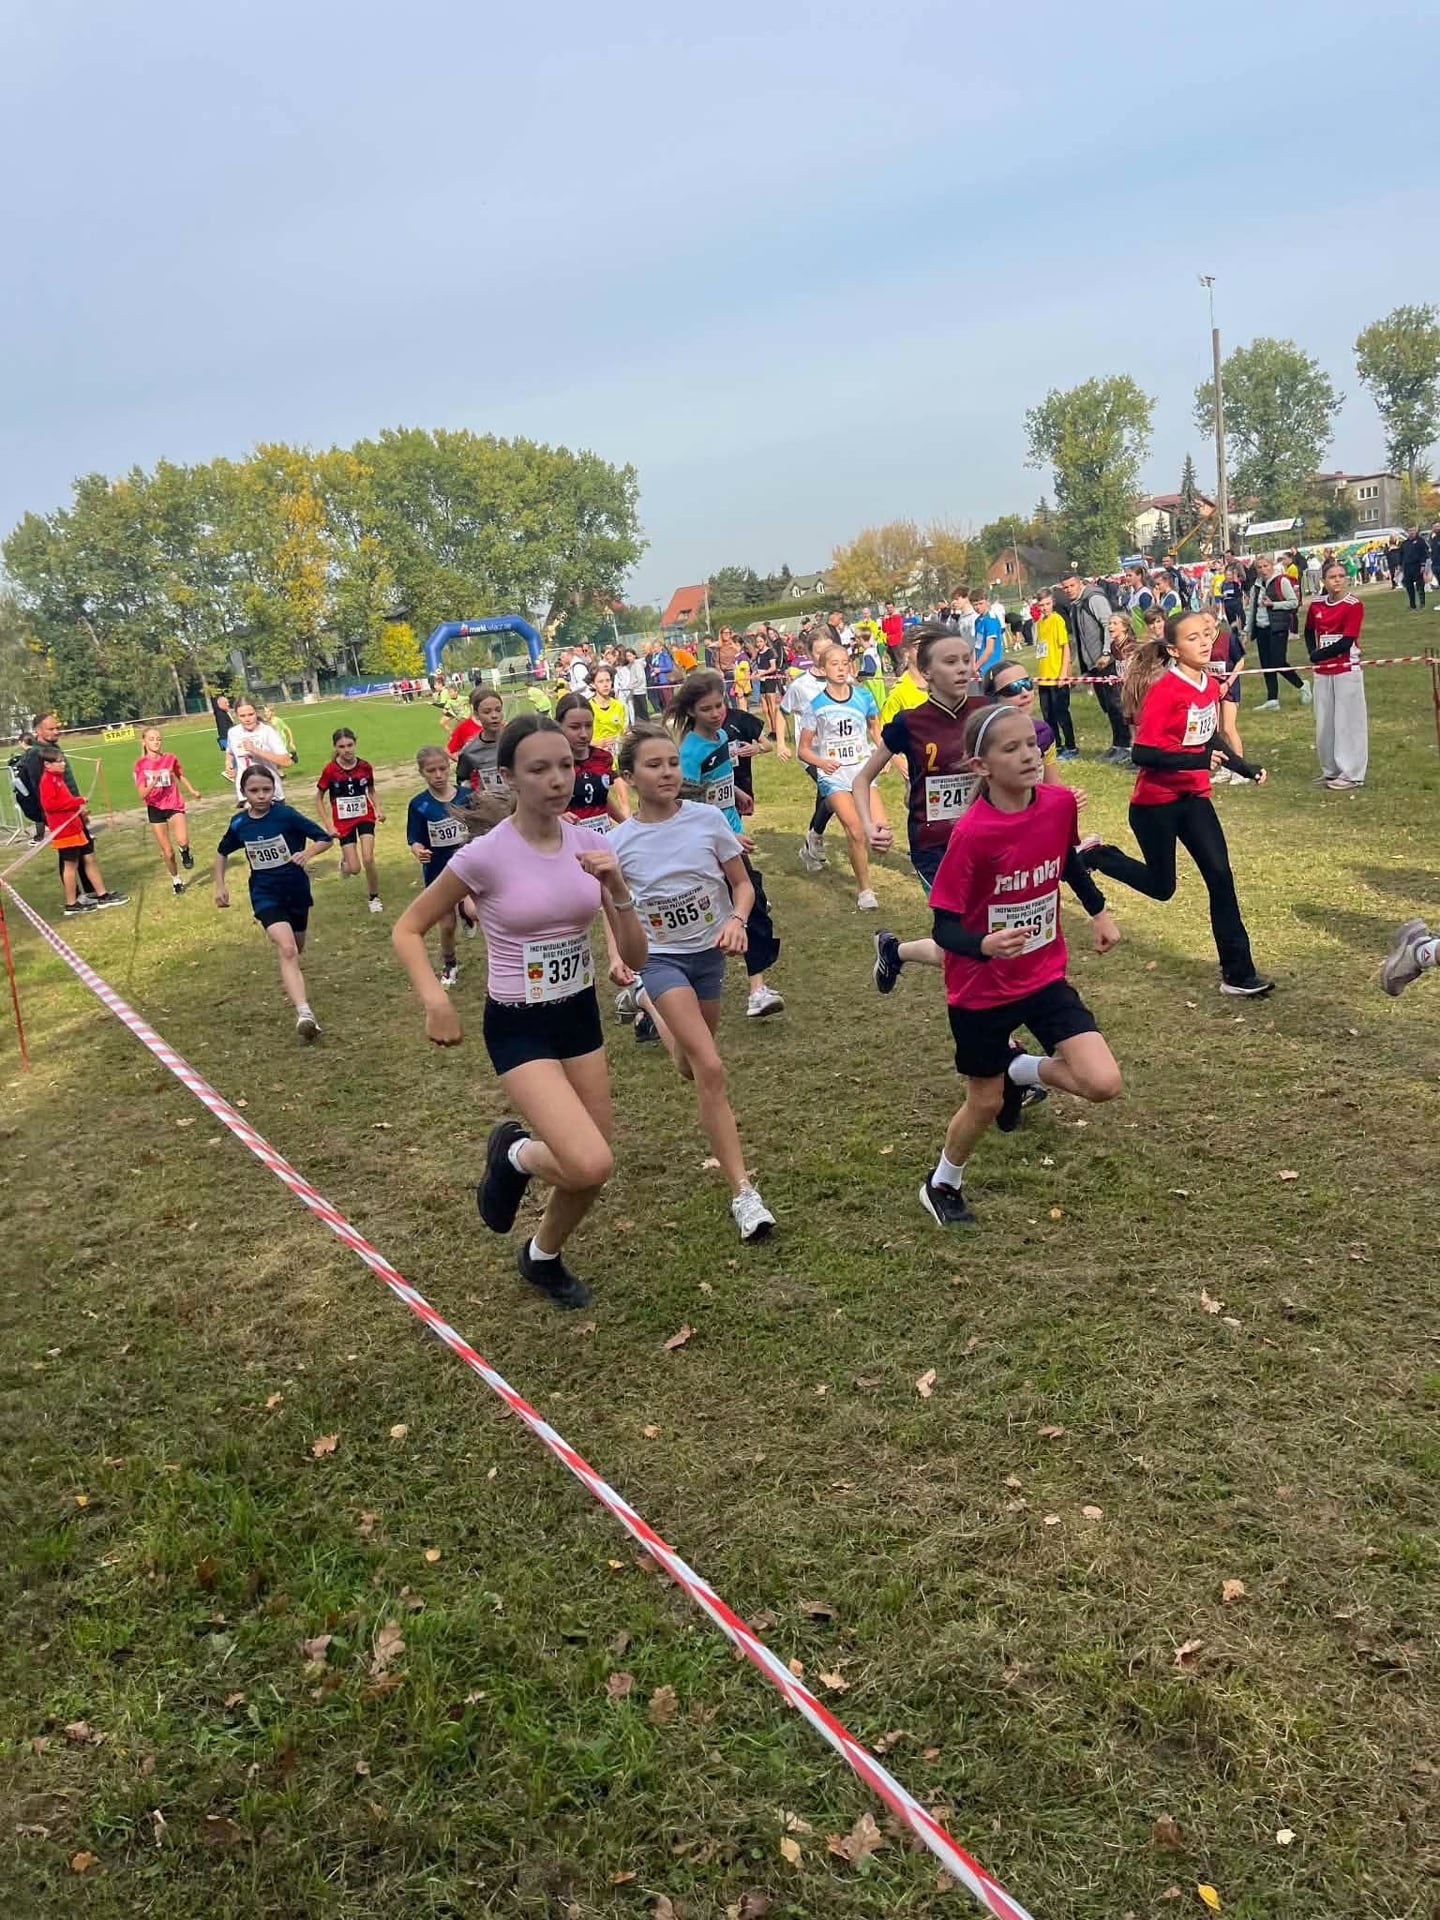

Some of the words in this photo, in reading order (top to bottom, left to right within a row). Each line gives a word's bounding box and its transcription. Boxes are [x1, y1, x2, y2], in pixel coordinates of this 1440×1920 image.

[105, 729, 132, 740] START
[837, 719, 852, 737] 15
[838, 746, 854, 759] 146
[925, 742, 939, 772] 2
[348, 784, 355, 795] 5
[584, 783, 594, 804] 3
[718, 784, 733, 801] 391
[347, 803, 360, 812] 412
[438, 826, 457, 840] 397
[257, 847, 279, 862] 396
[994, 870, 1029, 895] fair
[1033, 856, 1061, 888] play
[664, 903, 699, 929] 365
[549, 954, 580, 984] 337
